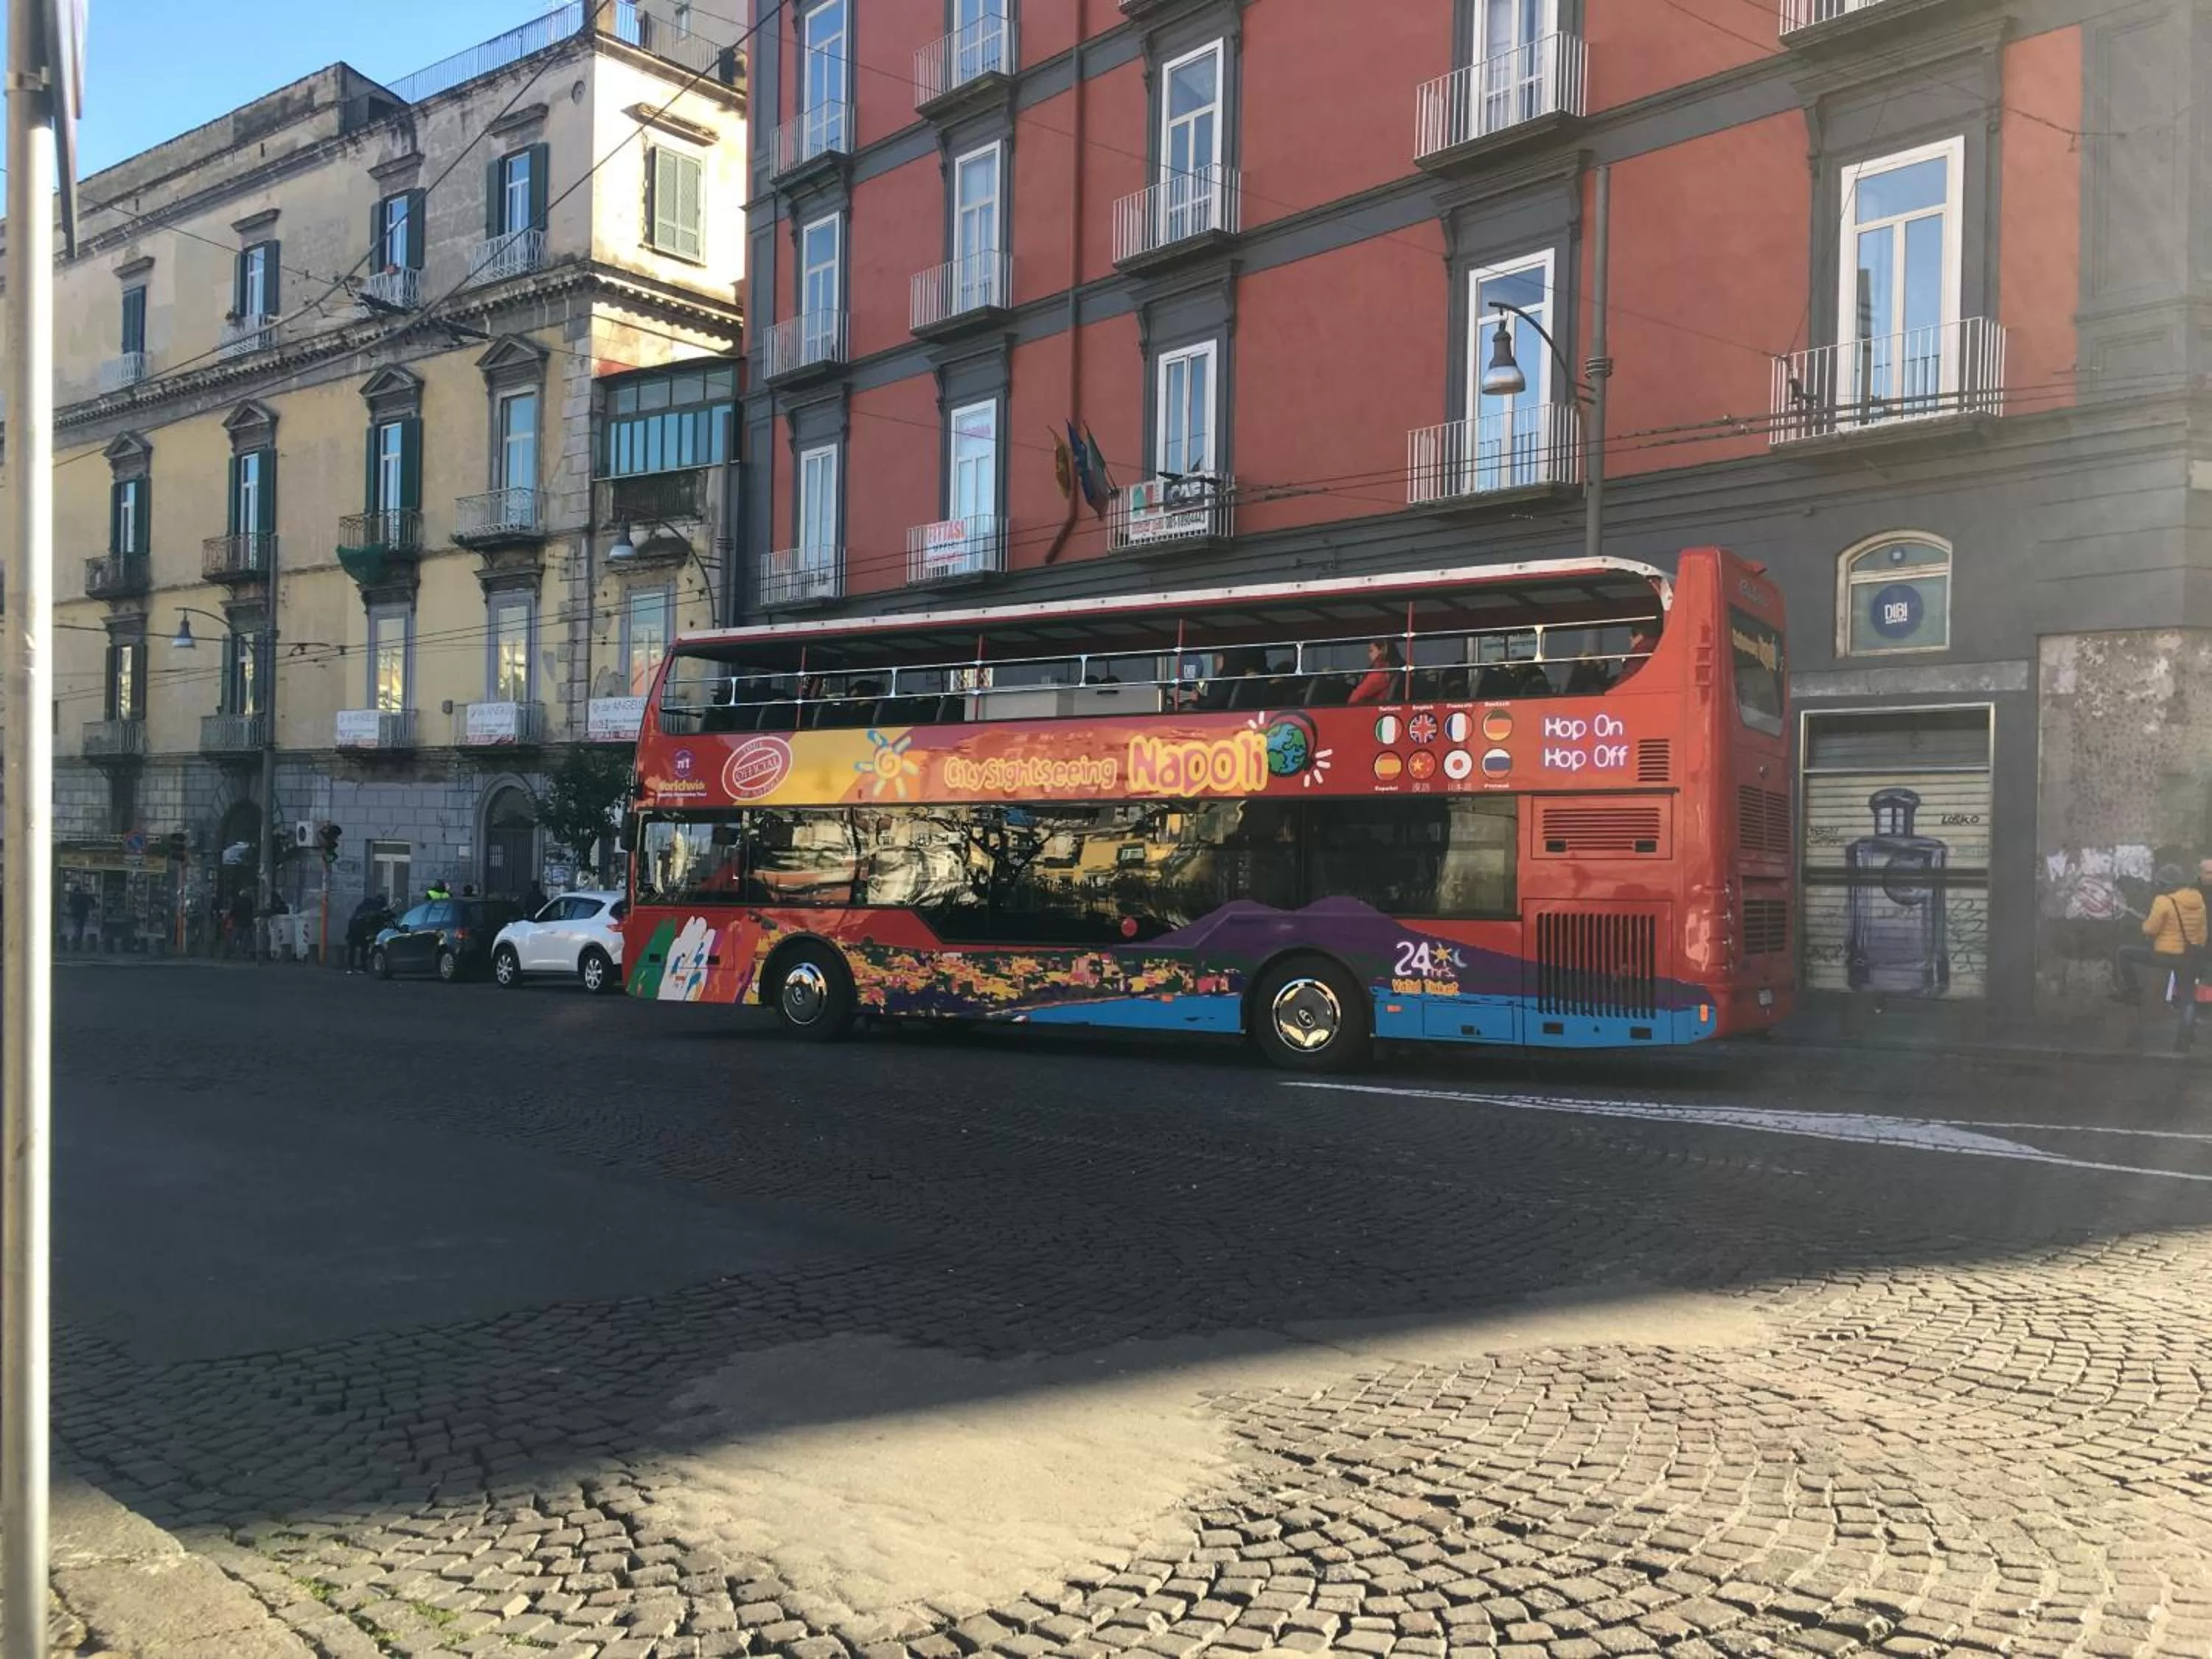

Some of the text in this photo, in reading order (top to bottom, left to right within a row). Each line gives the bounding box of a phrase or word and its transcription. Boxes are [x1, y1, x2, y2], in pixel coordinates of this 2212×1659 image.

[1545, 714, 1623, 740] Hop On
[1127, 730, 1267, 796] Napoli
[1545, 744, 1629, 771] Hop Off
